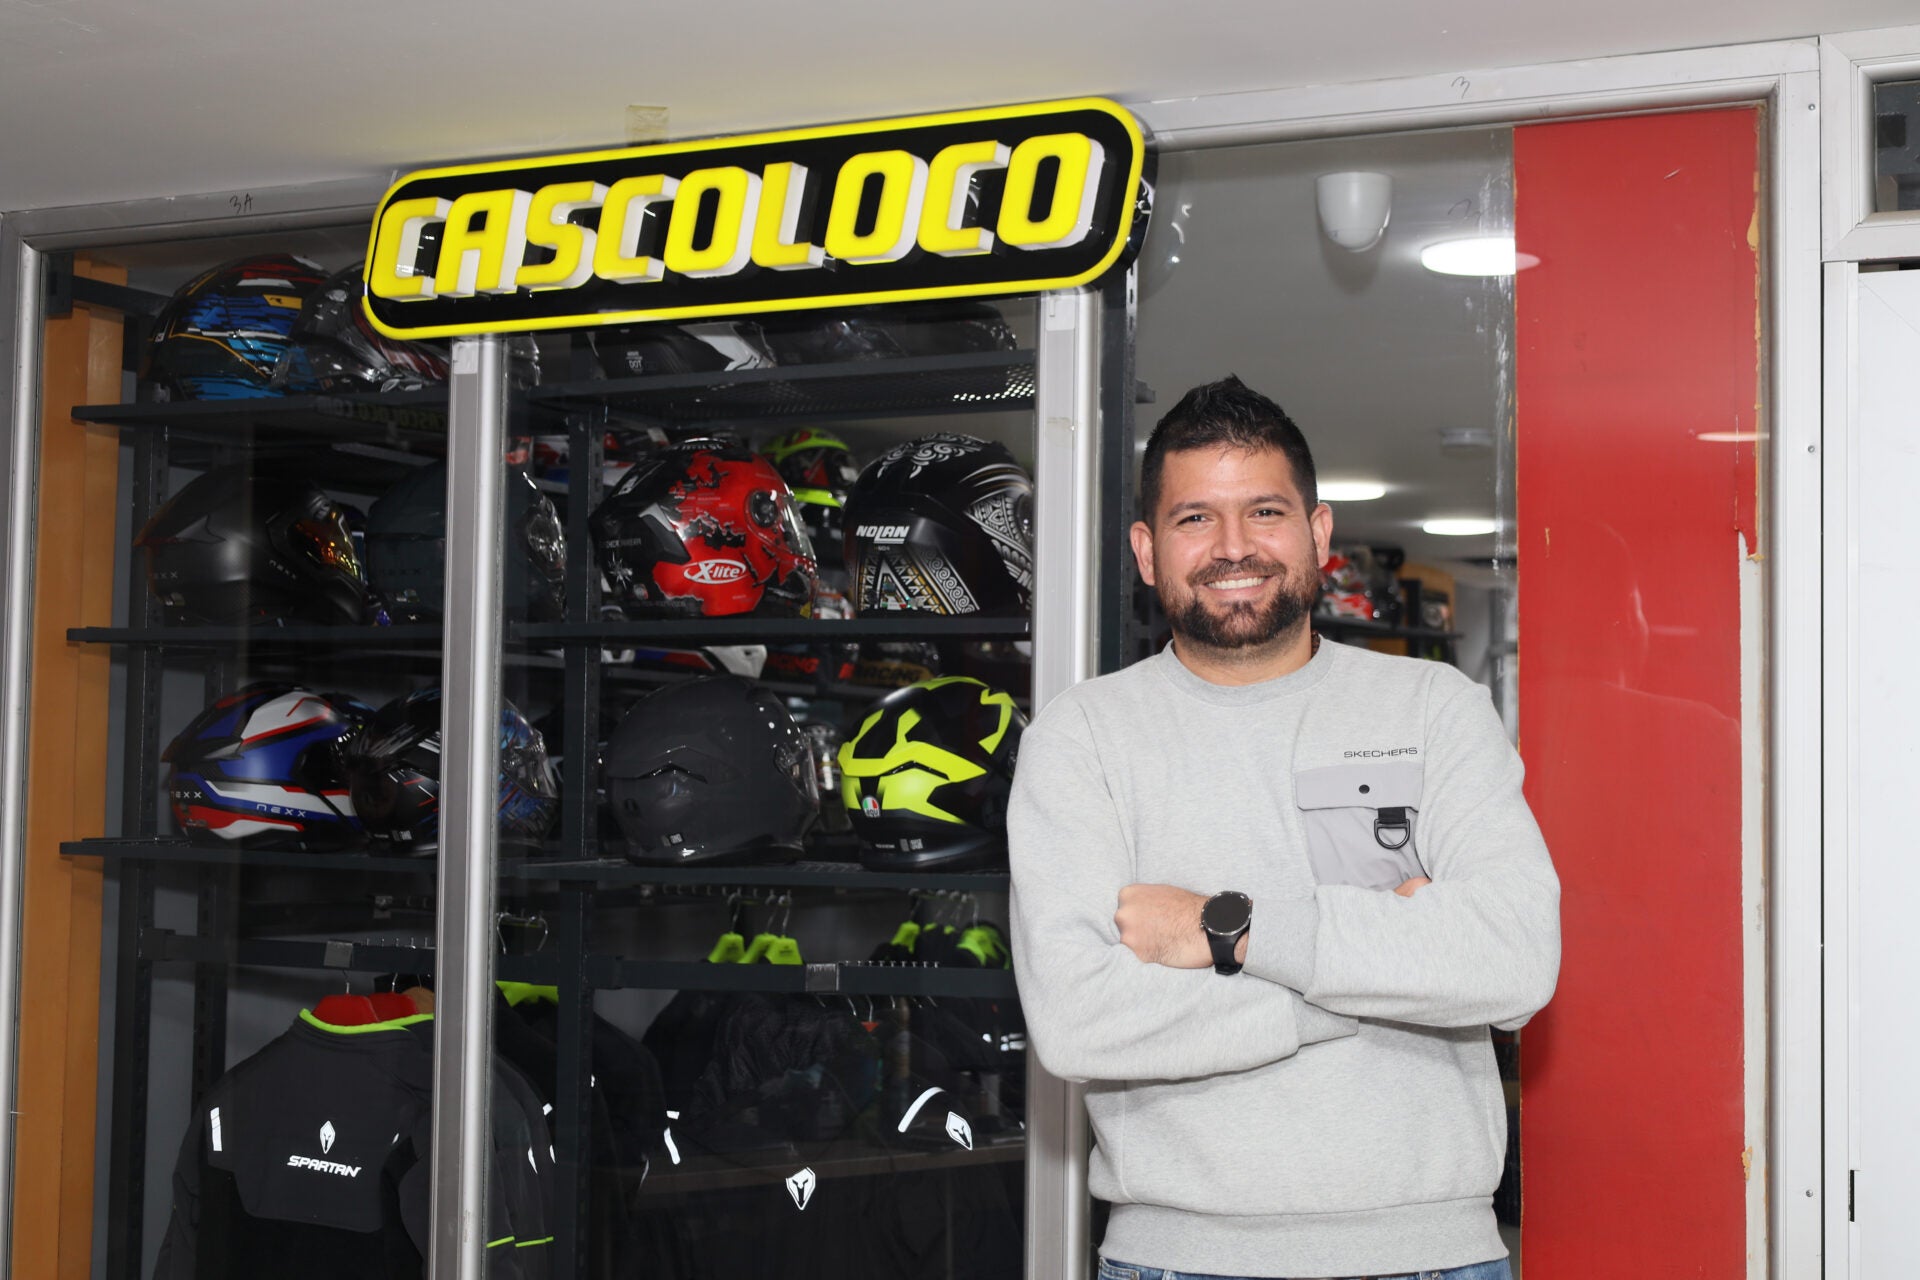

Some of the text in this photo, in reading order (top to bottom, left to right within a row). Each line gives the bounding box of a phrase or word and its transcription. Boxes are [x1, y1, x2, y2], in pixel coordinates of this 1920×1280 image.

[229, 193, 254, 215] 3A
[370, 132, 1105, 302] CASCOLOCO
[855, 524, 911, 545] NOLAN
[691, 562, 741, 582] X-lite
[1343, 746, 1418, 758] SKECHERS
[287, 1155, 362, 1178] SPARTAN
